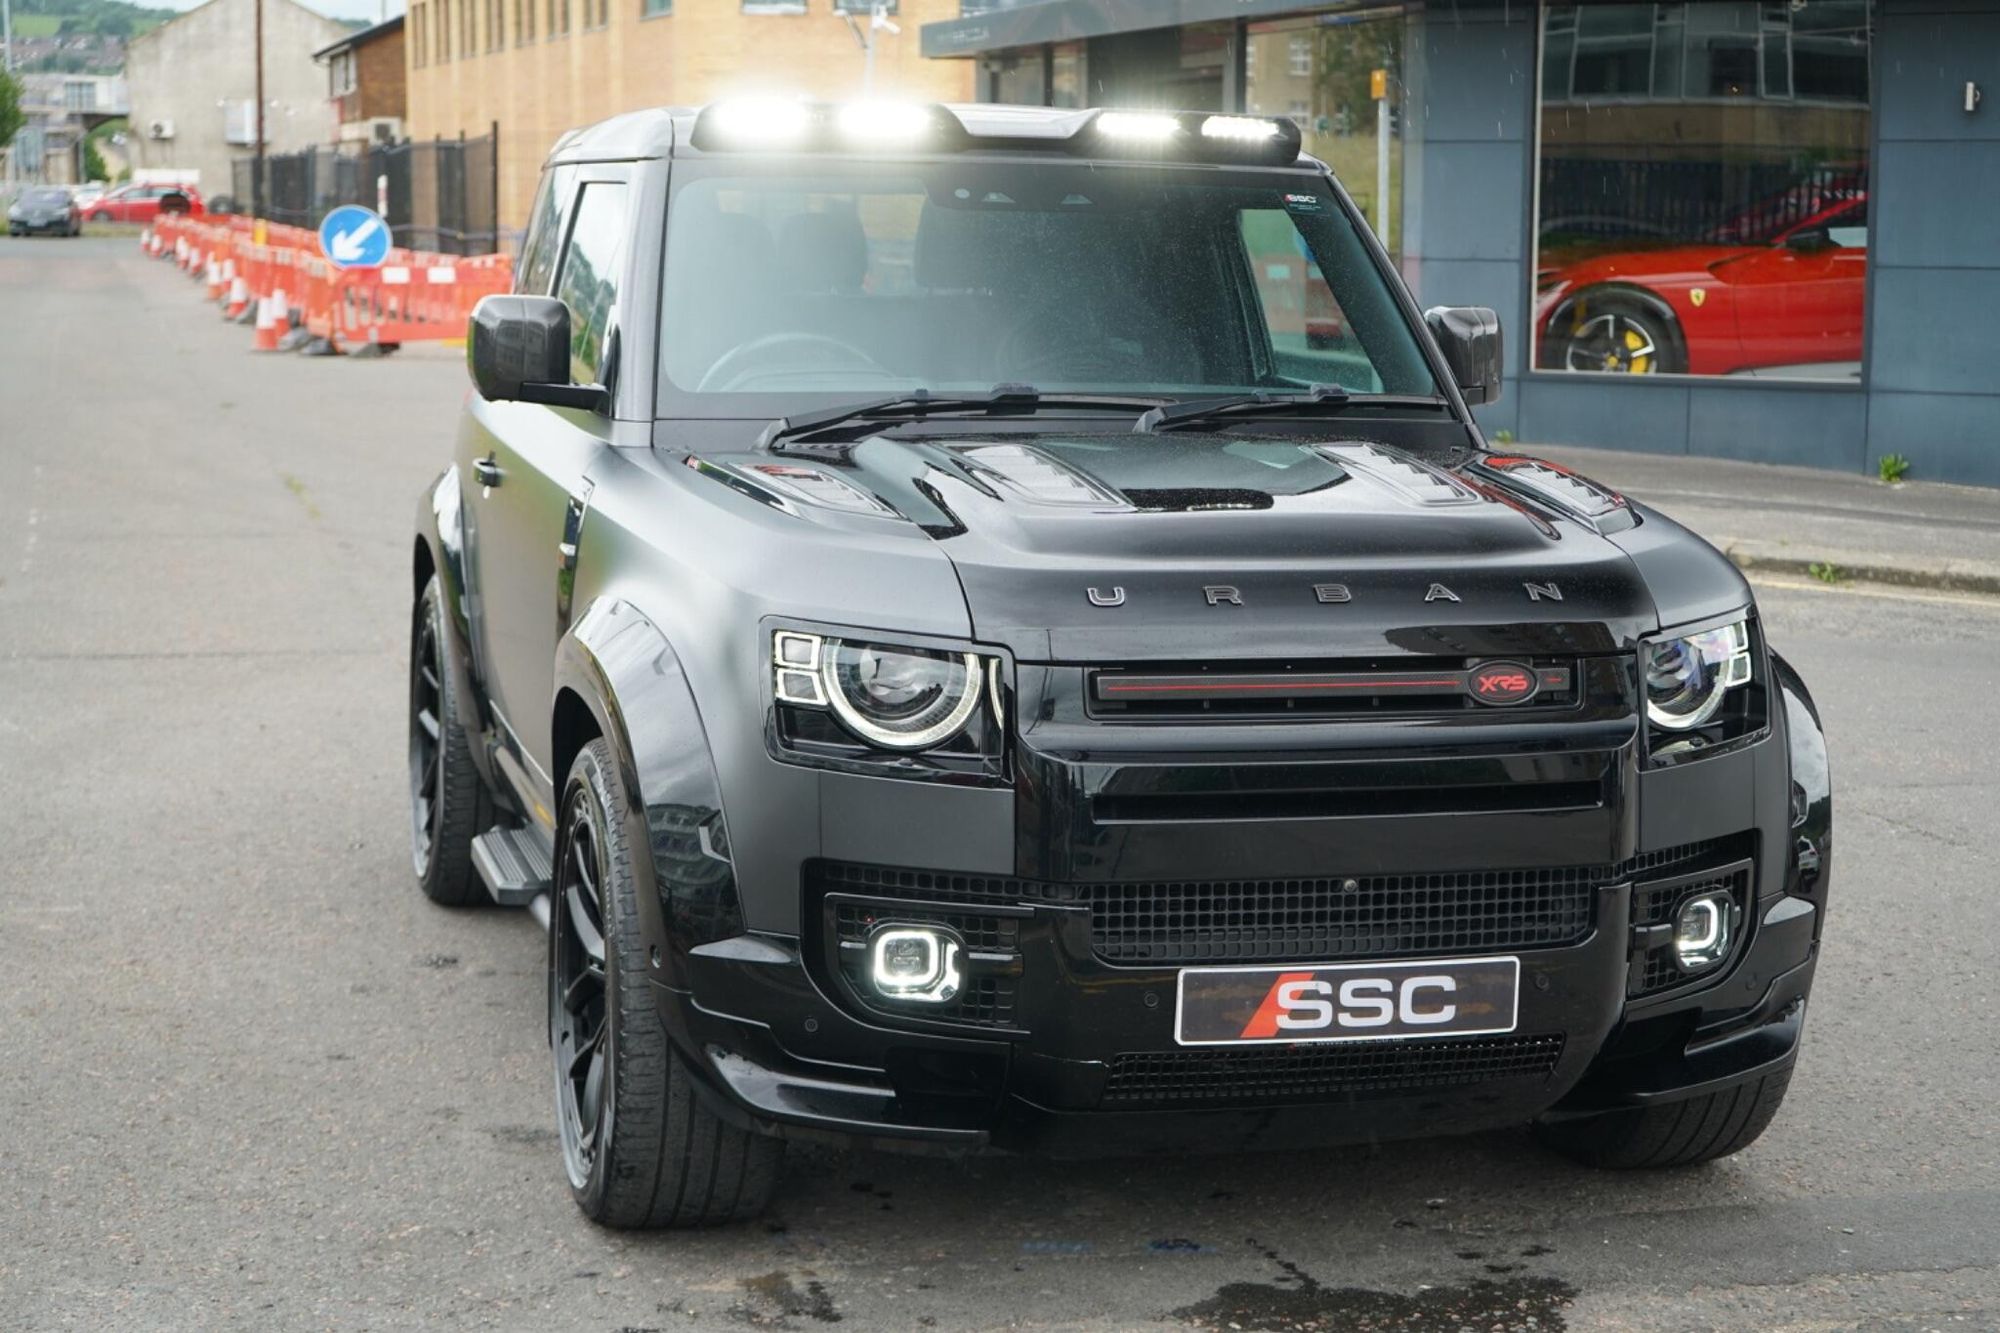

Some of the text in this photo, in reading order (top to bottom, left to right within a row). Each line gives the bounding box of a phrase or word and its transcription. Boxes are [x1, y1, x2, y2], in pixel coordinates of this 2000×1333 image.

[1087, 583, 1563, 606] URBAN
[1478, 673, 1527, 692] XRS
[1276, 975, 1456, 1029] SSC
